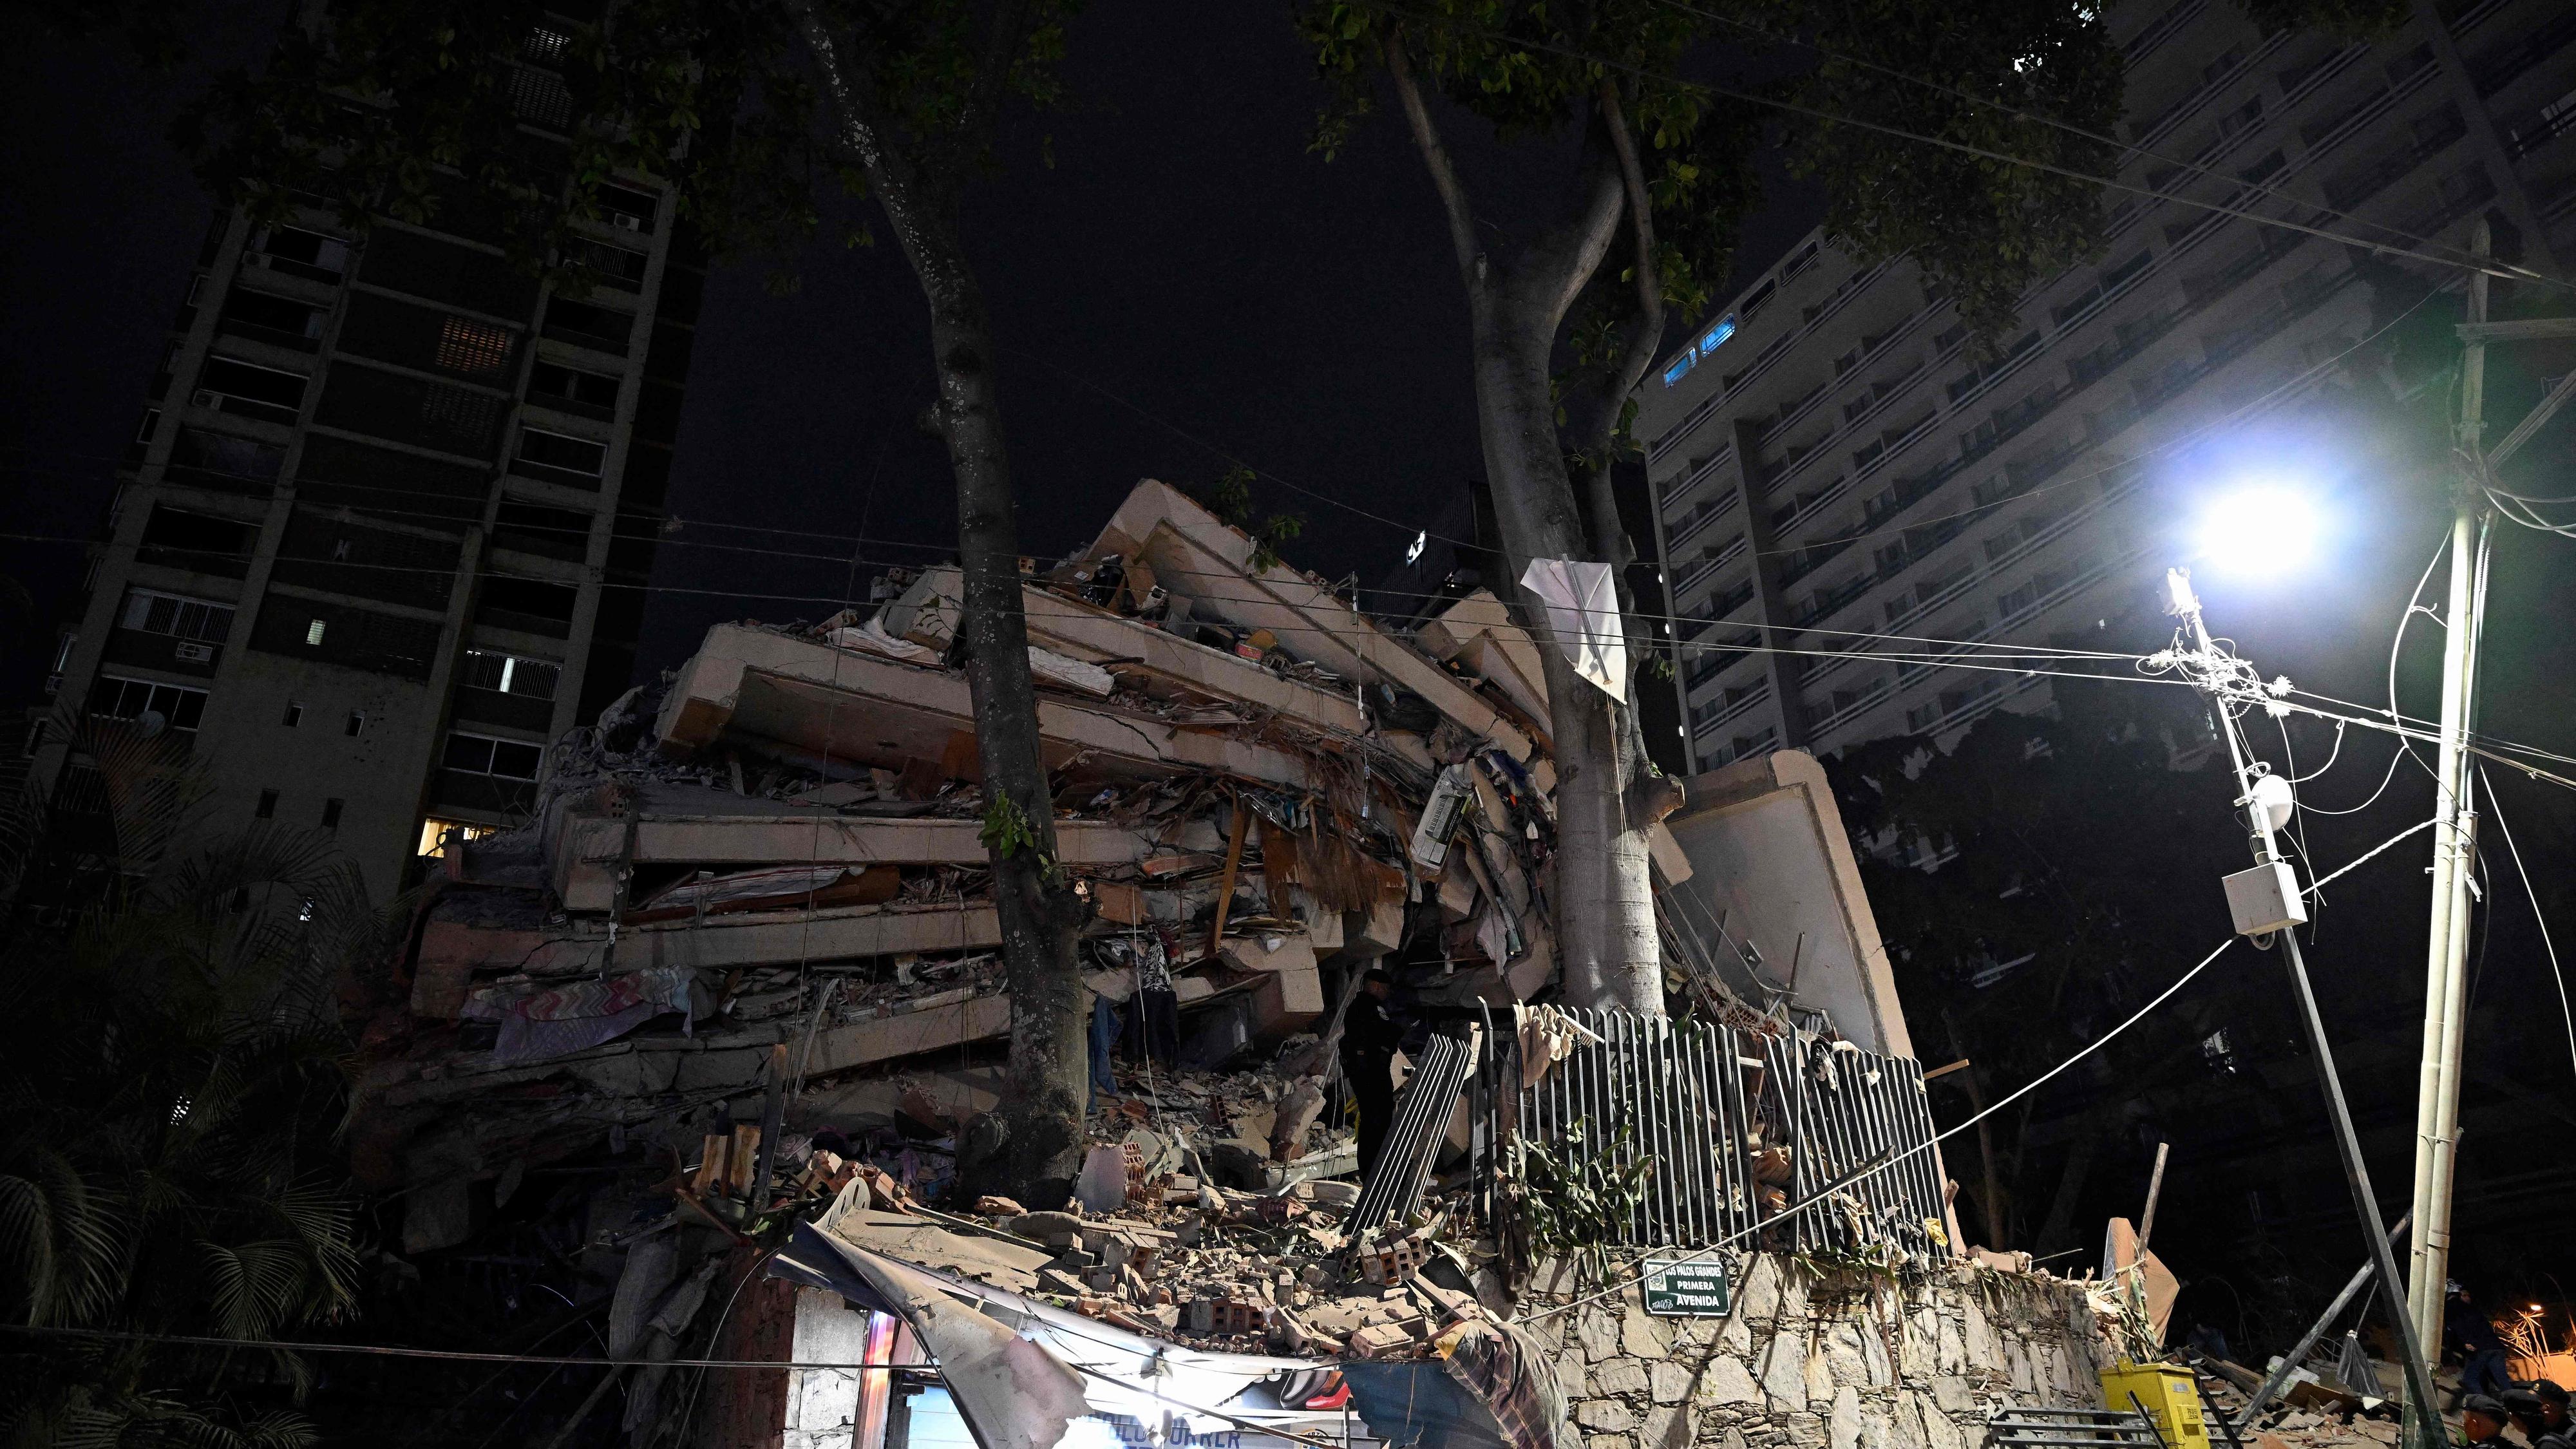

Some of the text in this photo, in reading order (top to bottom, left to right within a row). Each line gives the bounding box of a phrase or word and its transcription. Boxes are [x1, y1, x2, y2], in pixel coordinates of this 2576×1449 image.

[1676, 1265, 1695, 1276] PALOS
[1695, 1266, 1721, 1277] GRANDES
[1677, 1281, 1715, 1291] PRIMERA
[1676, 1294, 1719, 1307] AVENIDA
